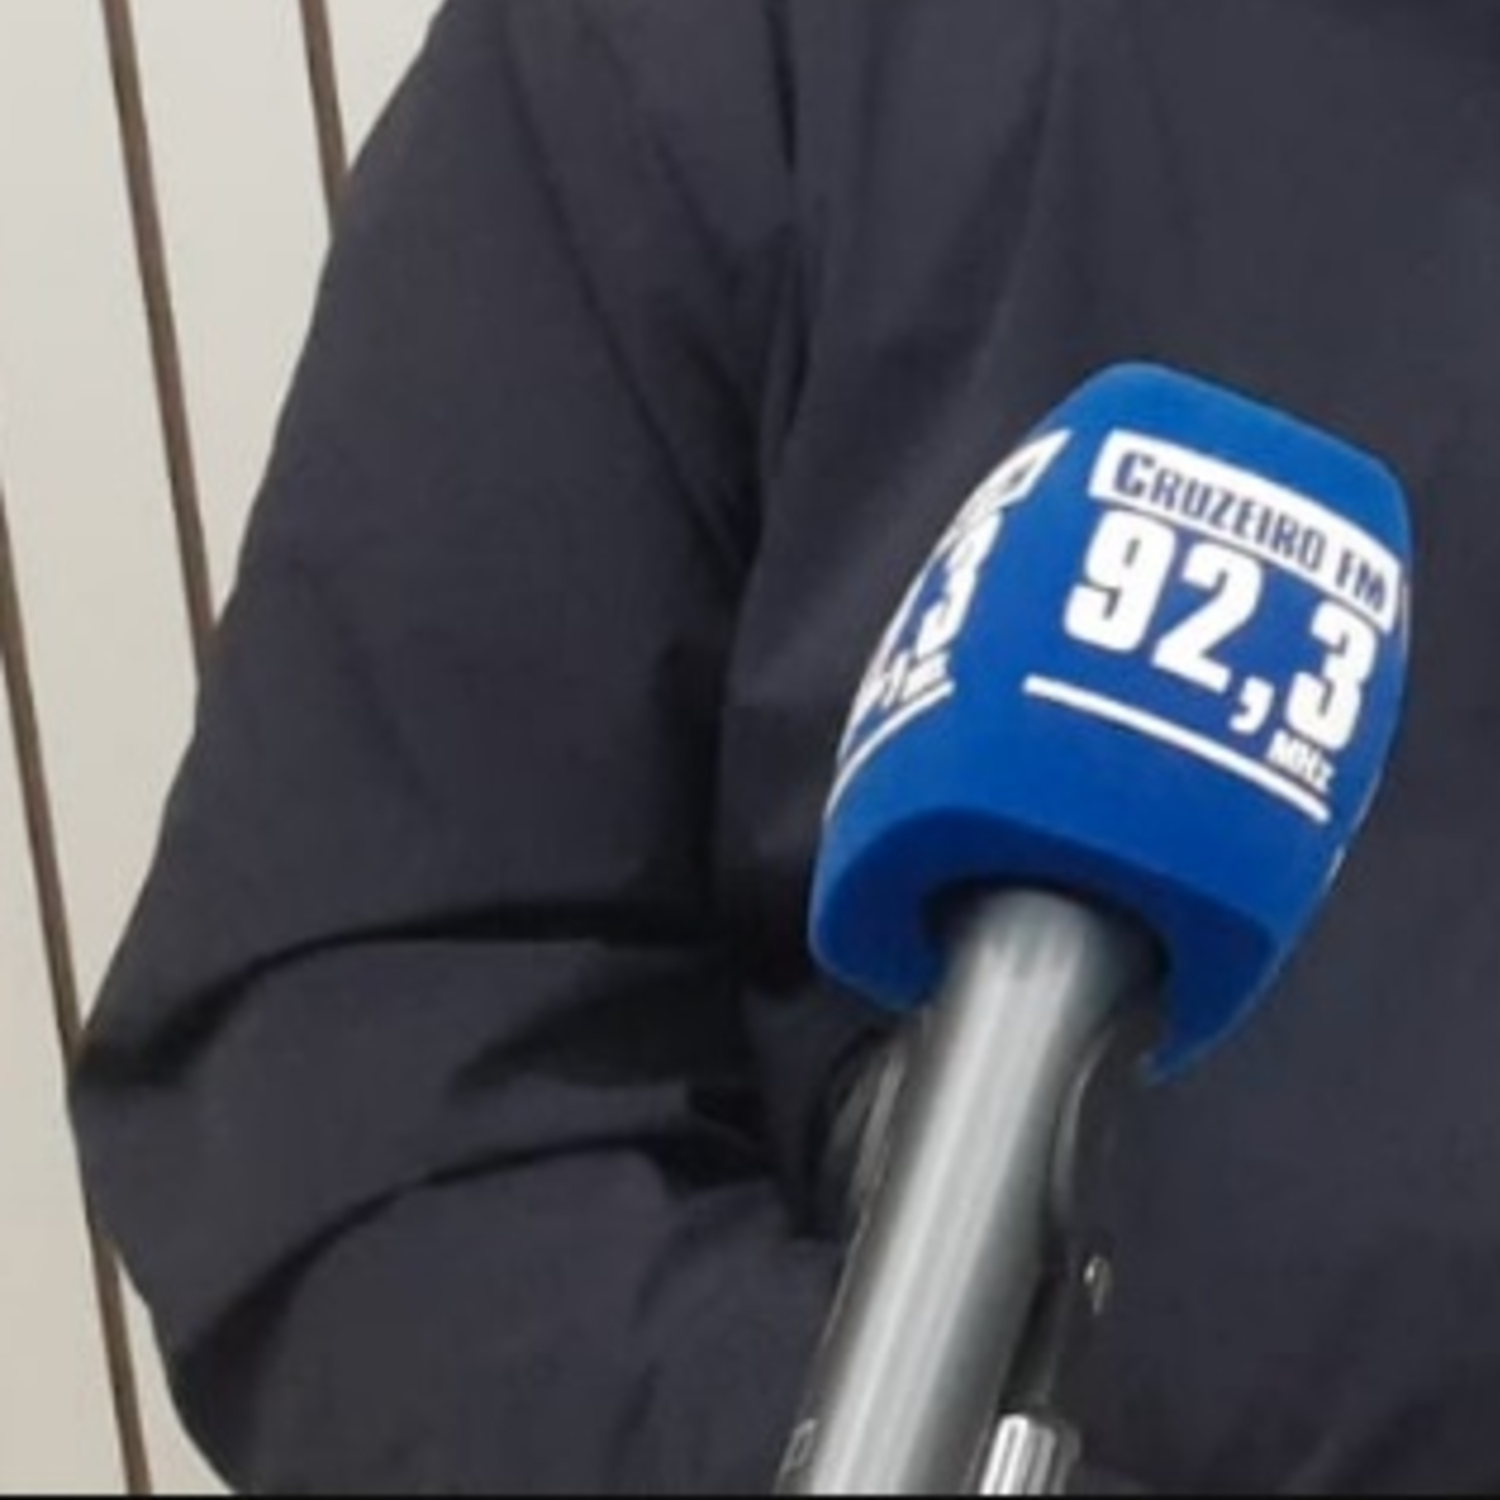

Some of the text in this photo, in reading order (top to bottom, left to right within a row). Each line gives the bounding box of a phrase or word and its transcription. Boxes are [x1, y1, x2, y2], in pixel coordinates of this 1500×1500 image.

[1063, 509, 1376, 750] 92,3
[1114, 451, 1328, 572] CRUZEIRO
[1336, 550, 1389, 613] FM
